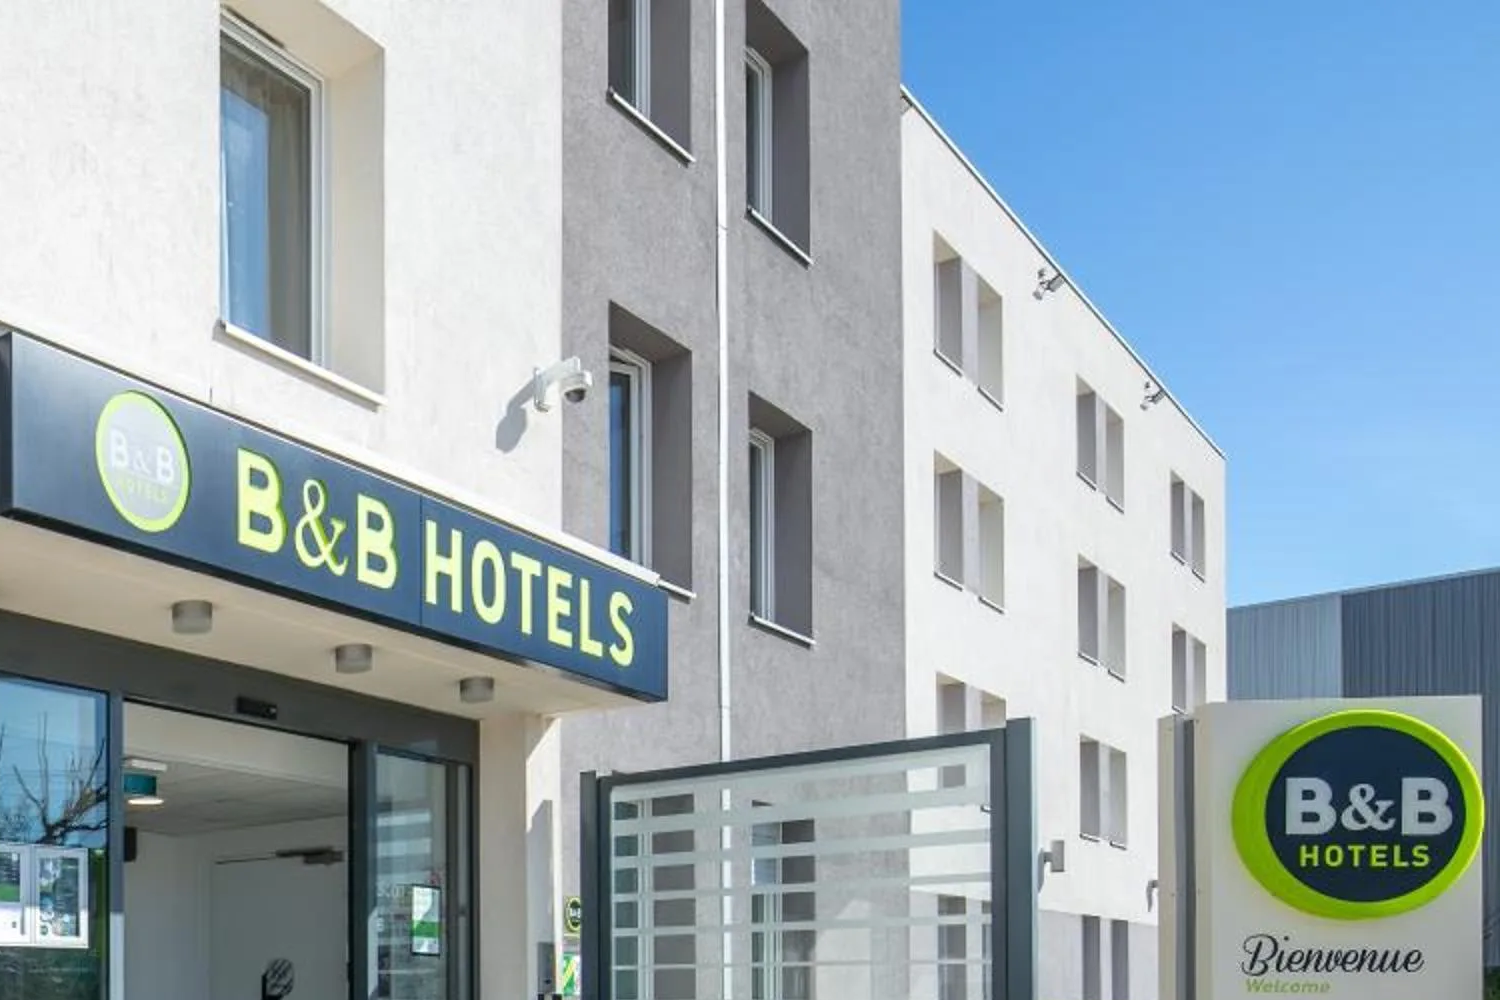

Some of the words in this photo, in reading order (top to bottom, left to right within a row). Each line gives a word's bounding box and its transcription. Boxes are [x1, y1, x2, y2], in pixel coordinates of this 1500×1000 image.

[110, 429, 174, 484] B&B
[237, 446, 398, 589] B&B
[425, 519, 635, 667] HOTELS
[1284, 776, 1453, 836] B&B
[1299, 844, 1431, 868] HOTELS
[1241, 933, 1425, 977] Bienvenue
[1245, 978, 1331, 994] Welcome
